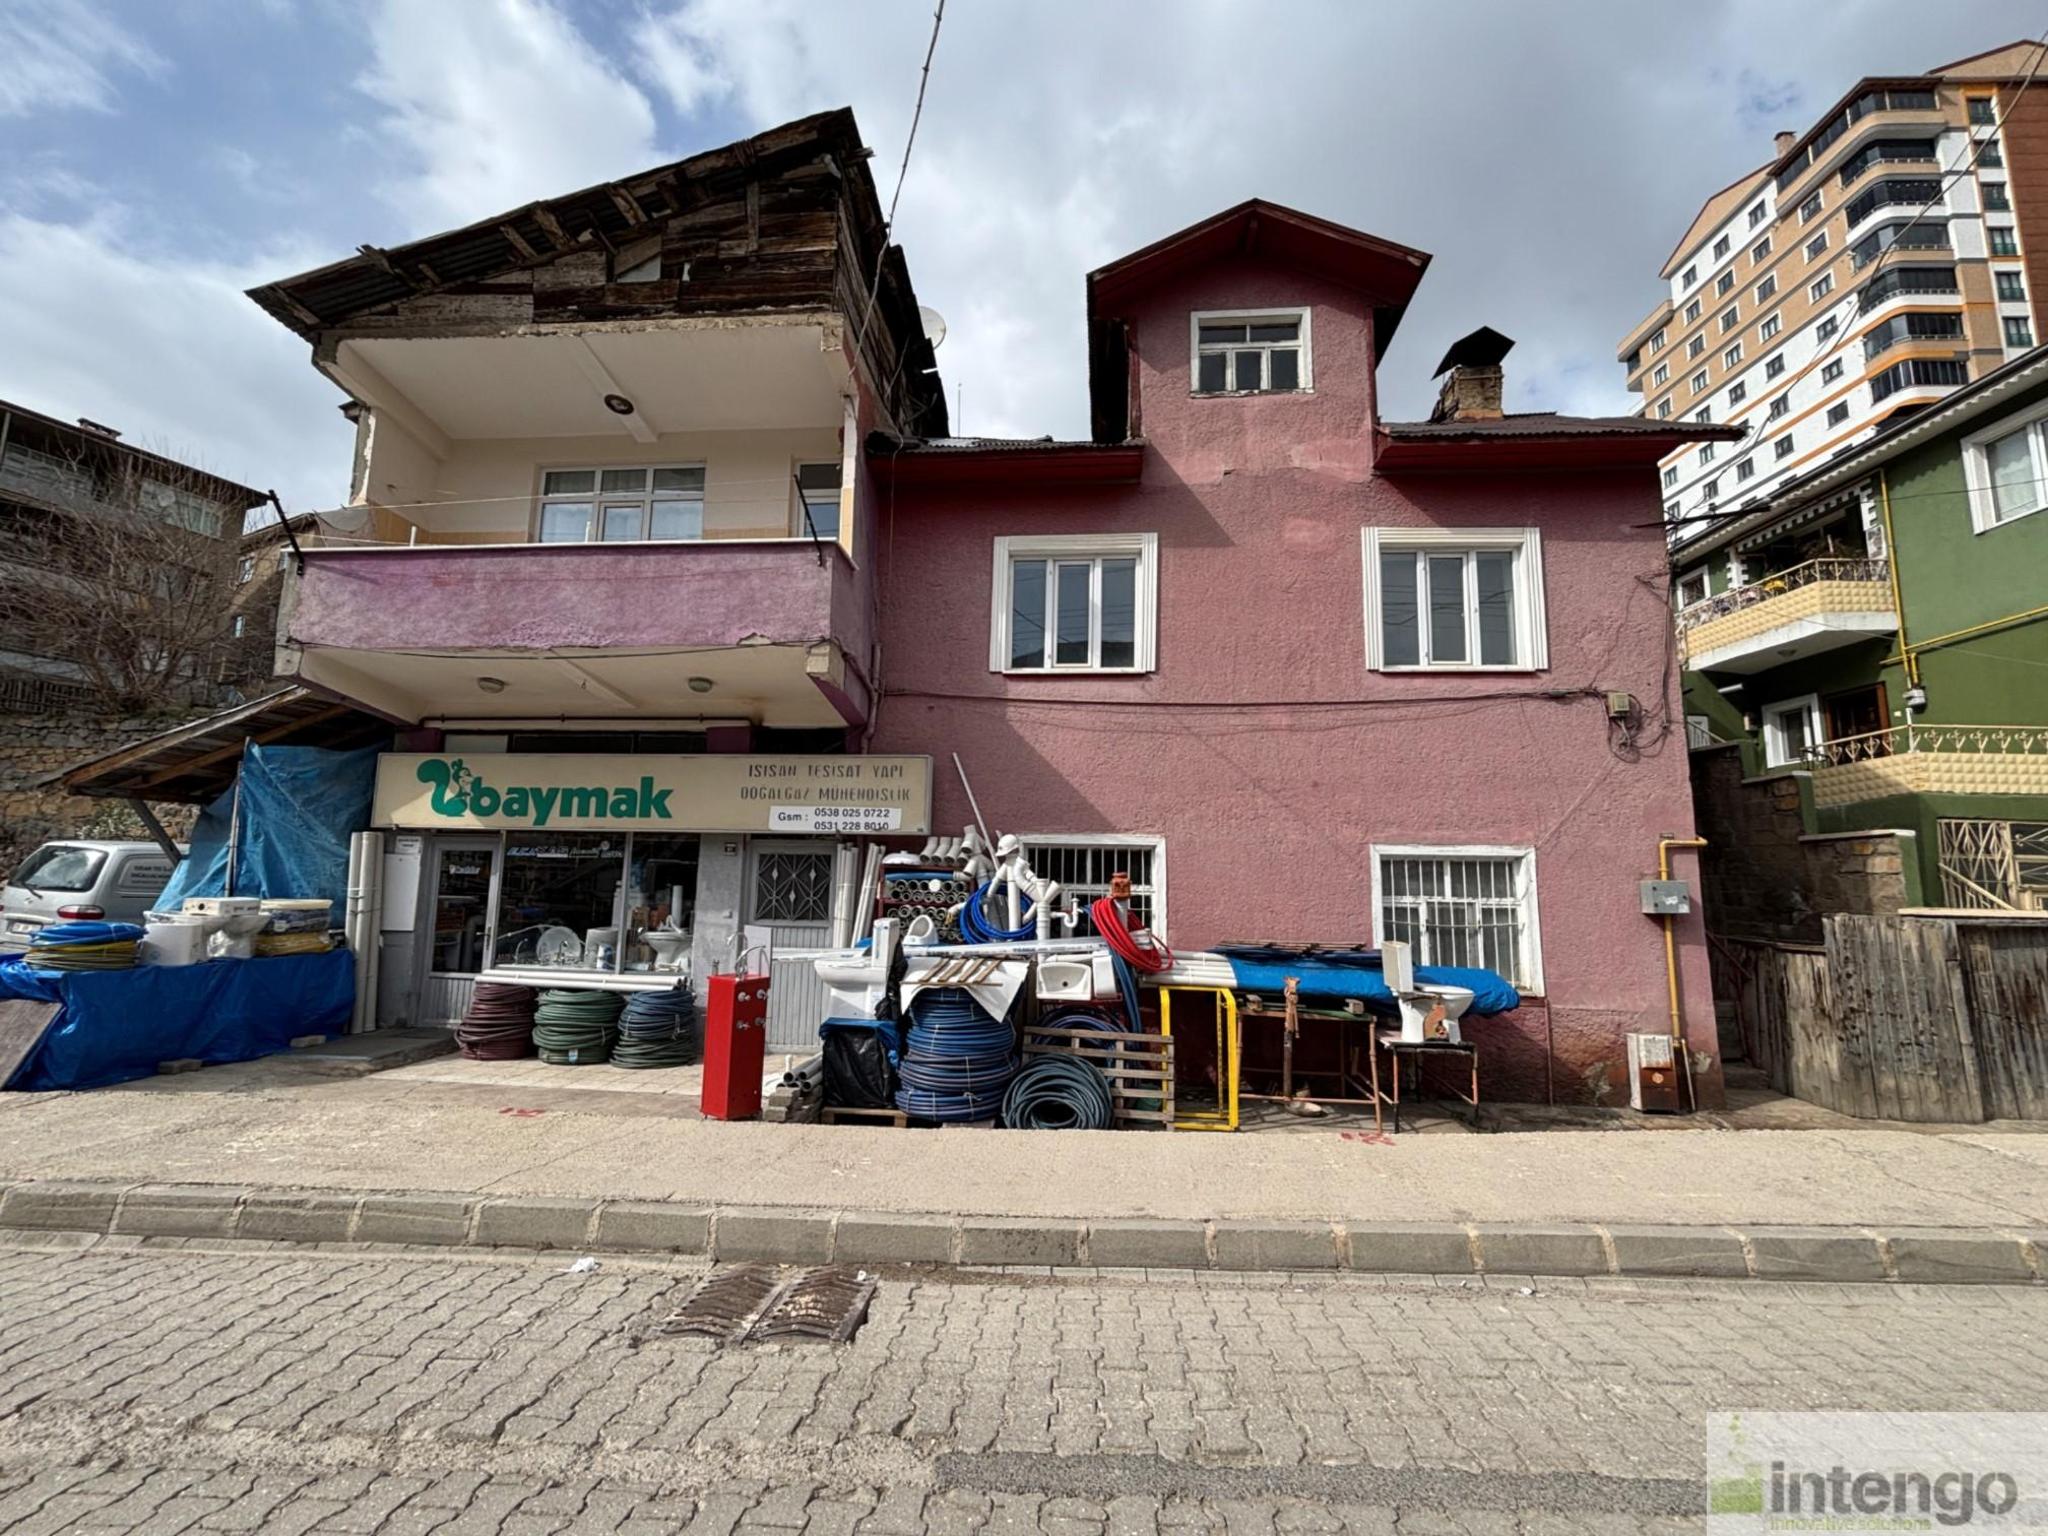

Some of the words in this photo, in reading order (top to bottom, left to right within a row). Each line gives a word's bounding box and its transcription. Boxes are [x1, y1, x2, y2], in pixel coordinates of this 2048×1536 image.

[872, 764, 904, 778] YAPI
[469, 776, 674, 826] baymak
[778, 811, 802, 821] Gsm
[814, 807, 840, 817] 0538
[842, 808, 861, 818] 025
[863, 808, 890, 818] 0722
[814, 821, 839, 831] 0531
[842, 821, 861, 831] 228
[863, 821, 889, 831] 8010
